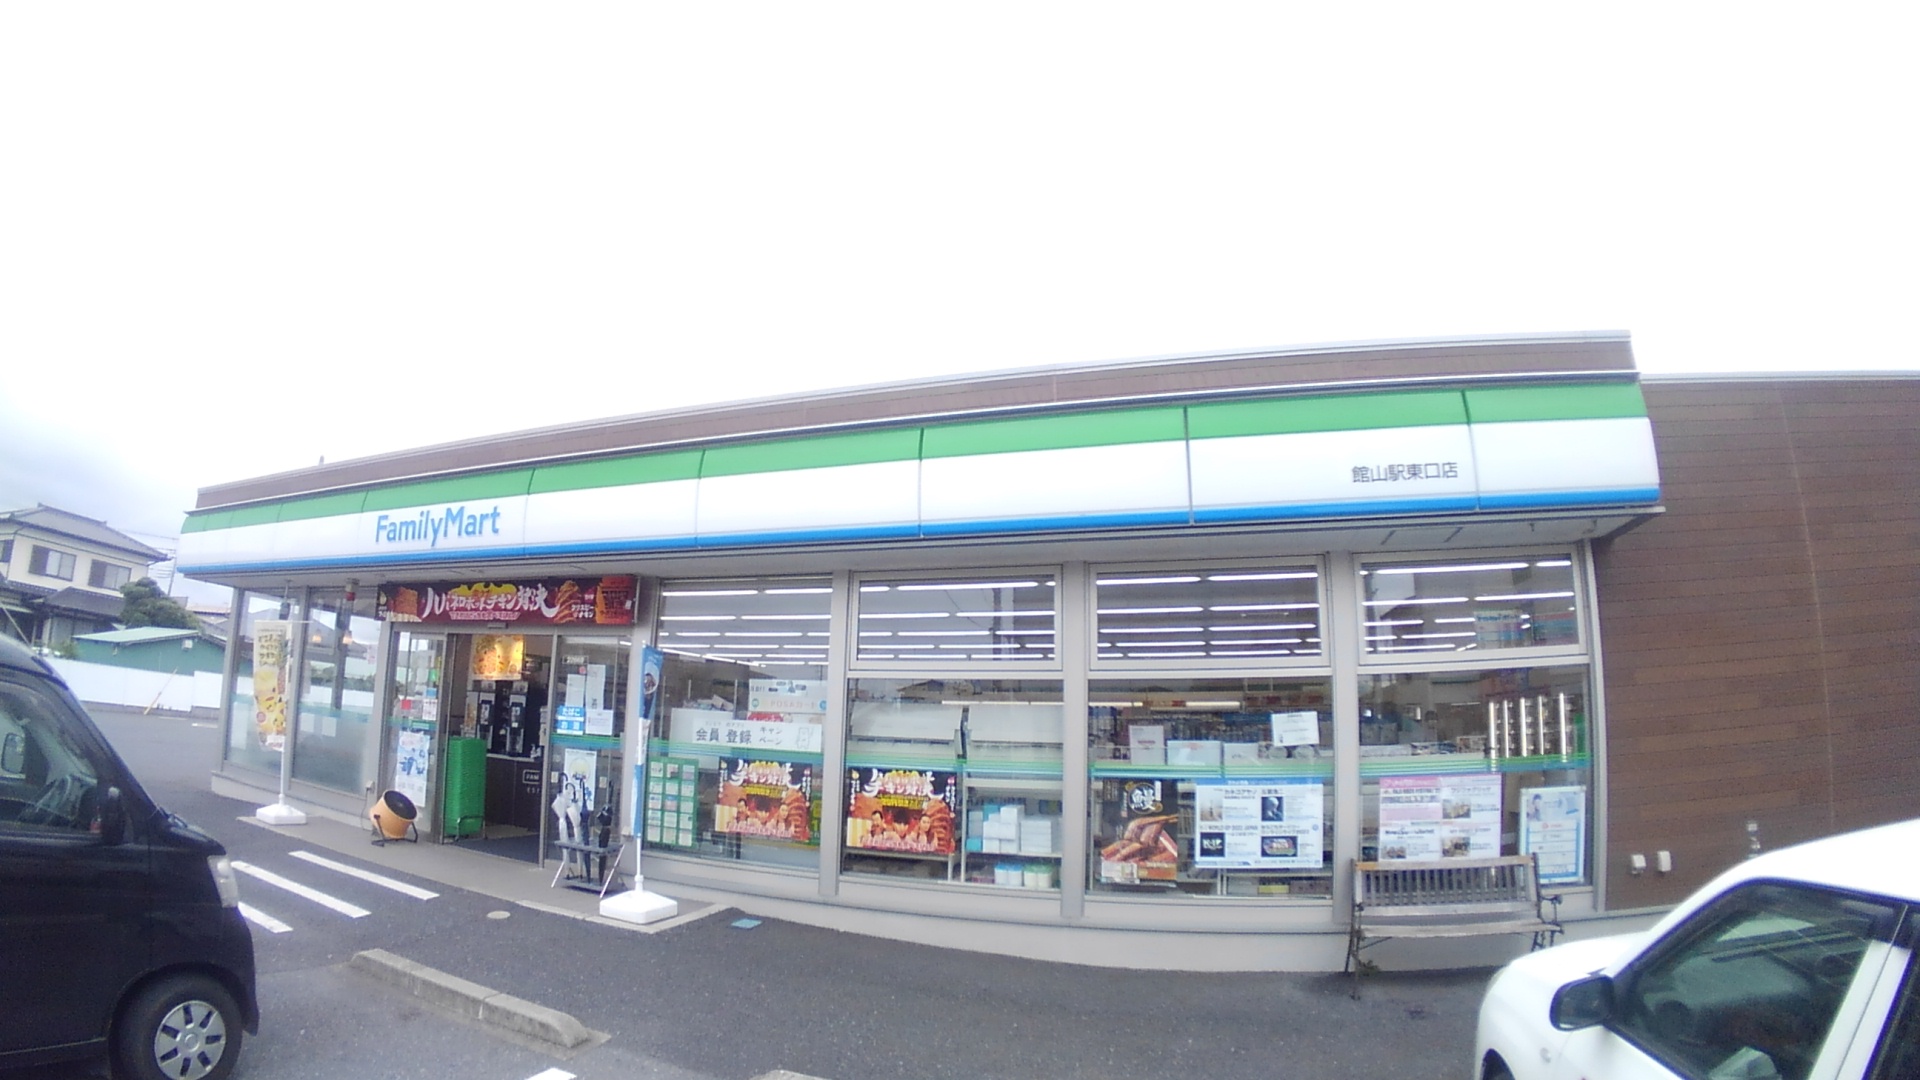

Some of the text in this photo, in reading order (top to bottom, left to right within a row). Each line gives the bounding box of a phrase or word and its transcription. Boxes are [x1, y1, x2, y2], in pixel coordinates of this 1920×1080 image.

[1352, 463, 1458, 482] 館山駅東口店
[375, 505, 501, 547] FamilyMart
[696, 728, 752, 744] 会員 登録
